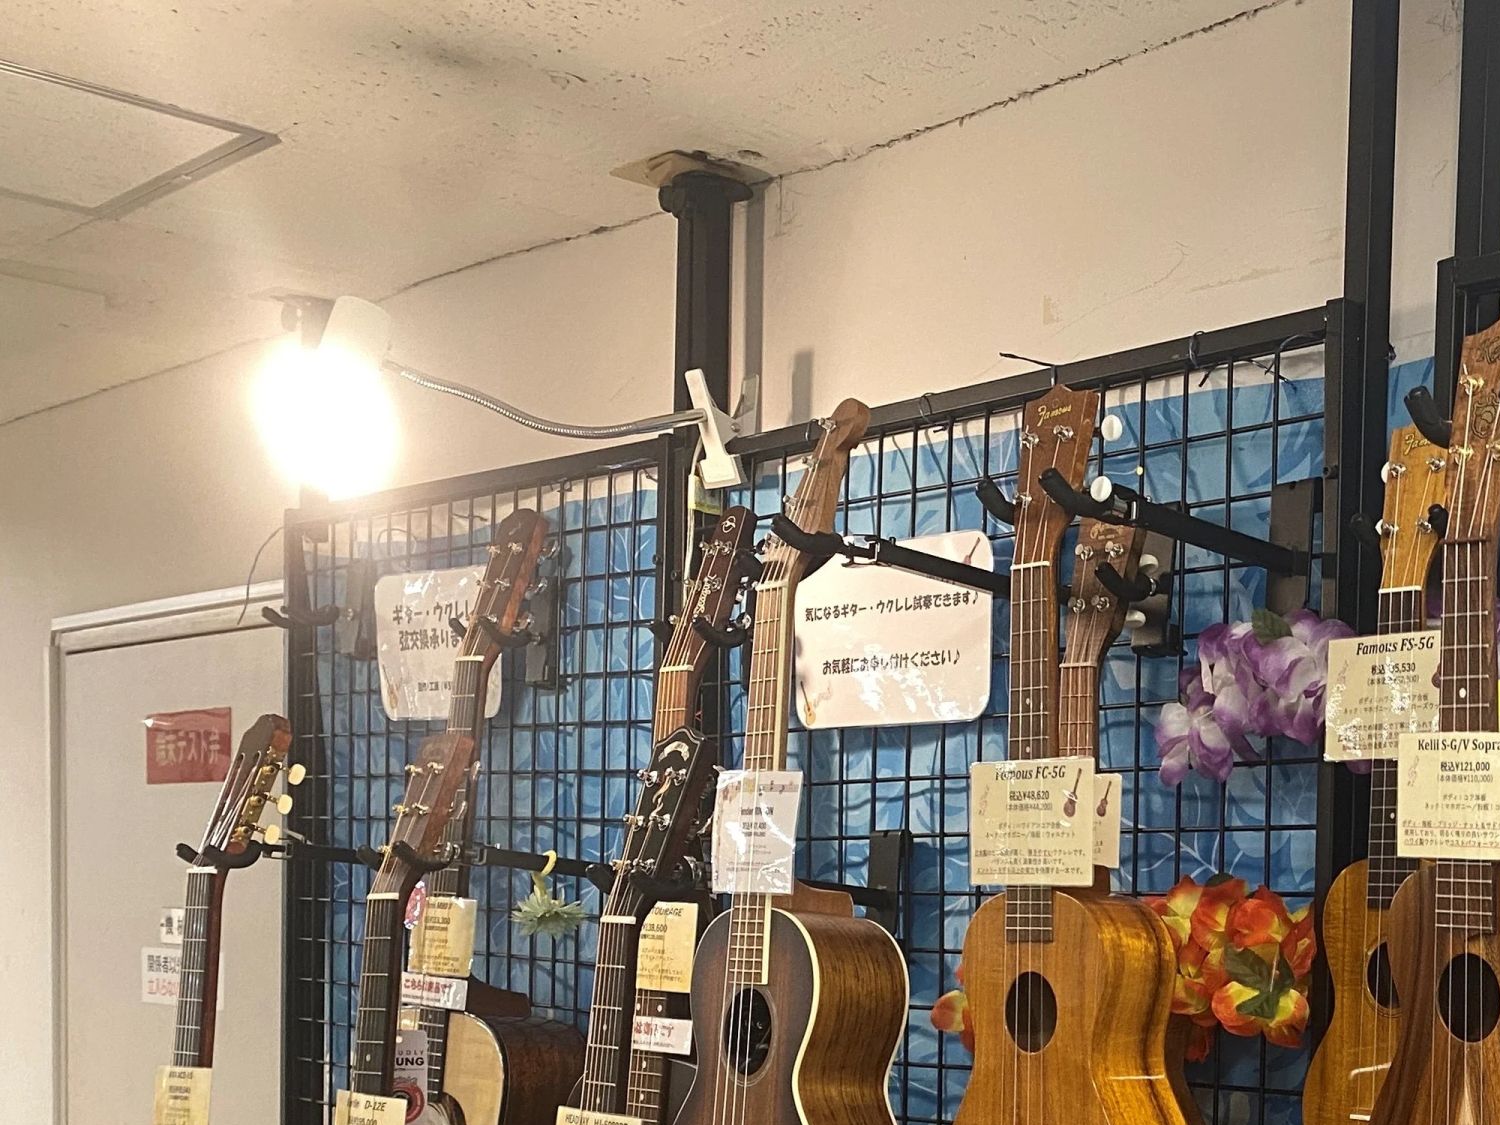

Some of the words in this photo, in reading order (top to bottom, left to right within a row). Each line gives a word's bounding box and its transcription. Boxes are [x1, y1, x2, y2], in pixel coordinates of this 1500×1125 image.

[1400, 636, 1435, 652] FS-5G
[1035, 765, 1066, 780] FC-5G
[395, 1057, 424, 1066] UNG
